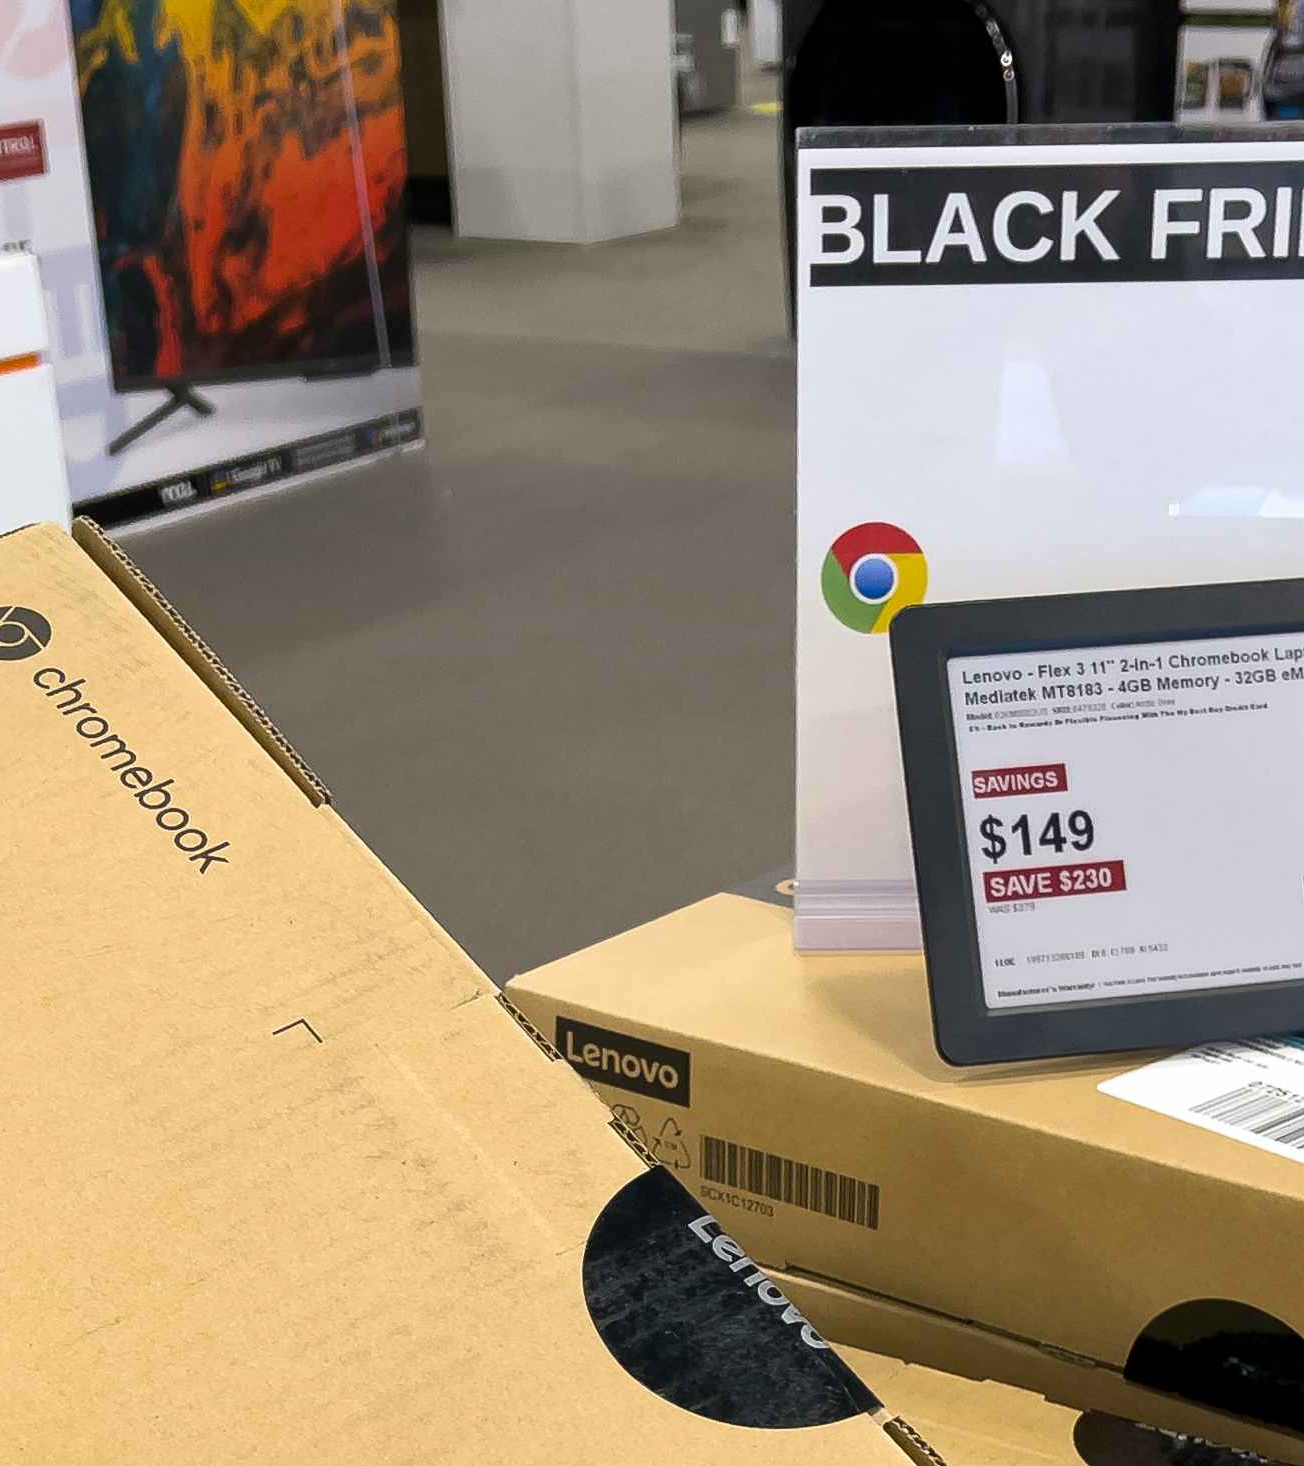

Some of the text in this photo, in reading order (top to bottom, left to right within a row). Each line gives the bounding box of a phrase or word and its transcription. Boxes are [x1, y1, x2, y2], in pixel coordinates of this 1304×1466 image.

[811, 185, 1120, 266] BLACK
[961, 668, 1023, 685] Lenovo
[1037, 664, 1072, 679] Flex
[1076, 662, 1086, 676] 3
[1168, 648, 1271, 669] Chromebook
[964, 687, 1038, 707] Mediatek
[1041, 682, 1104, 701] MT8183
[1117, 679, 1153, 694] 4GB
[1156, 674, 1220, 692] Memory
[1234, 668, 1277, 685] 32GB
[32, 666, 230, 874] chromebook
[973, 771, 1059, 795] SAVINGS
[979, 809, 1095, 865] $149
[990, 866, 1113, 898] SAVE $230
[566, 1031, 679, 1090] Lenovo
